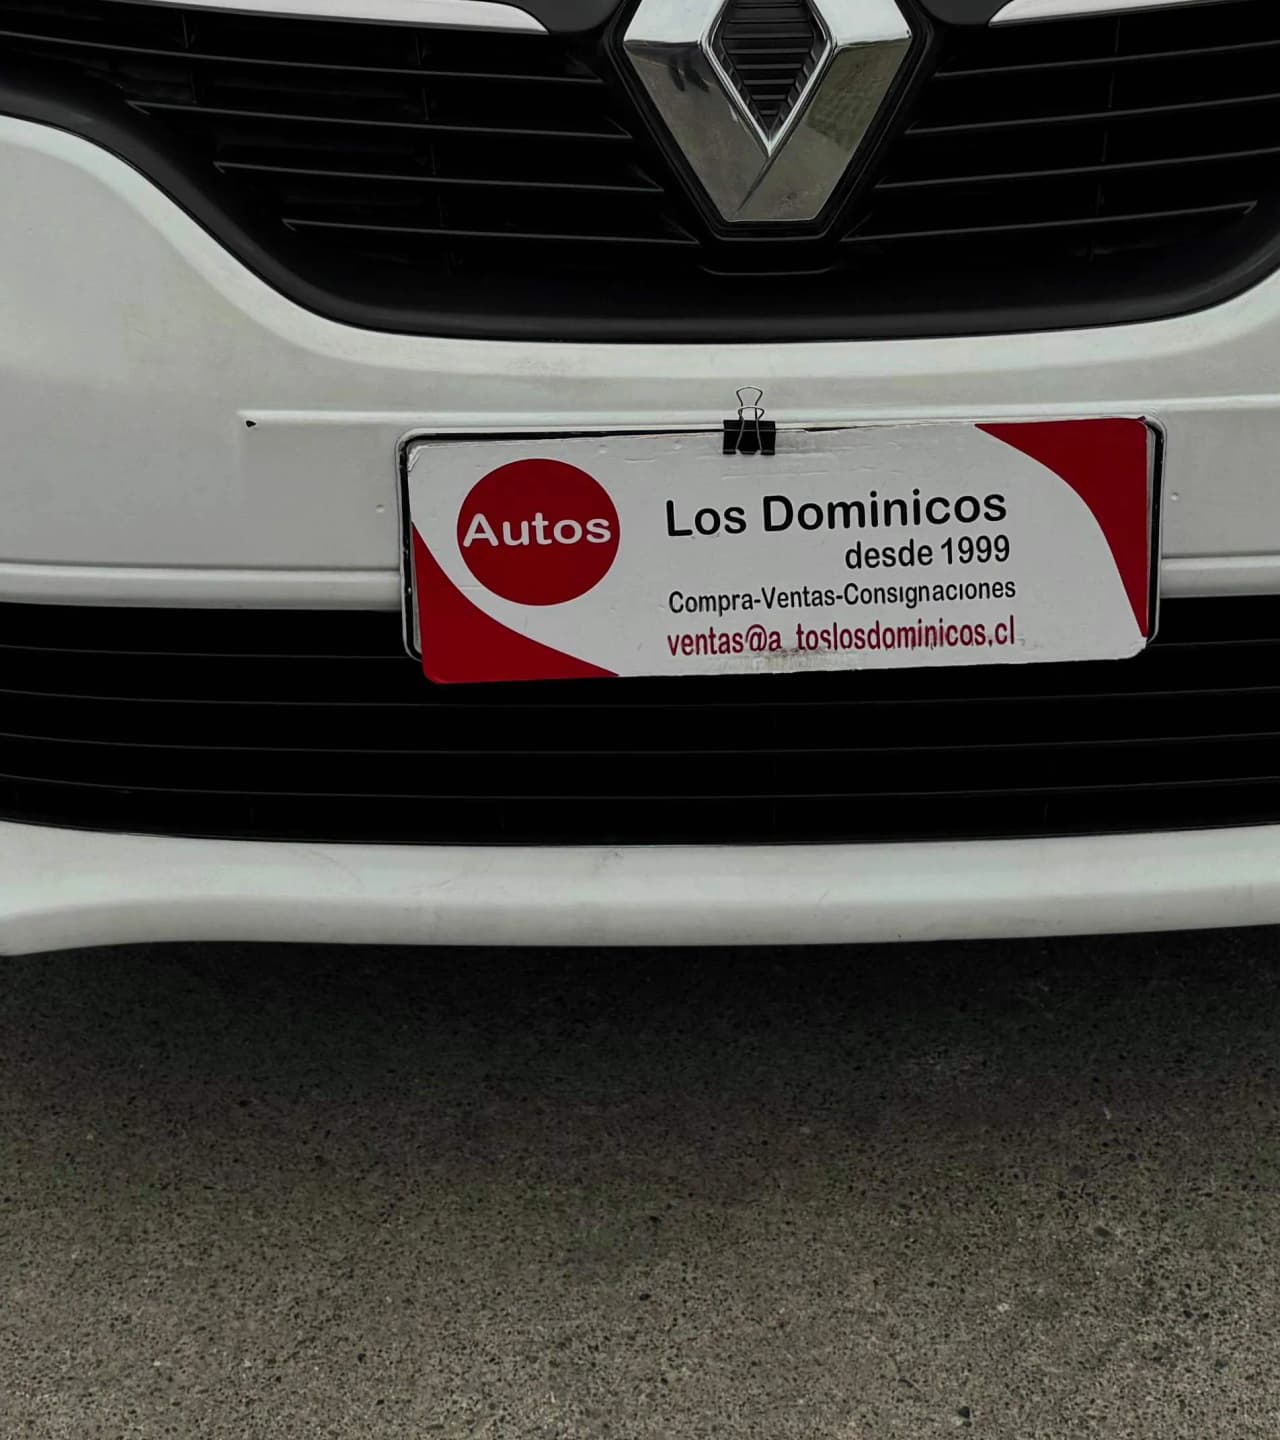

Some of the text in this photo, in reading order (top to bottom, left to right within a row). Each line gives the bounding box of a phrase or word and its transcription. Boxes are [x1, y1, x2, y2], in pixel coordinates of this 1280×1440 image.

[463, 512, 612, 547] Autos
[666, 488, 1007, 537] Los Dominicos
[845, 534, 1010, 570] desde 1999
[668, 581, 1016, 617] Compra-Ventas-Consignaciones
[667, 614, 1015, 657] ventas@atoslosdominicos.cl
